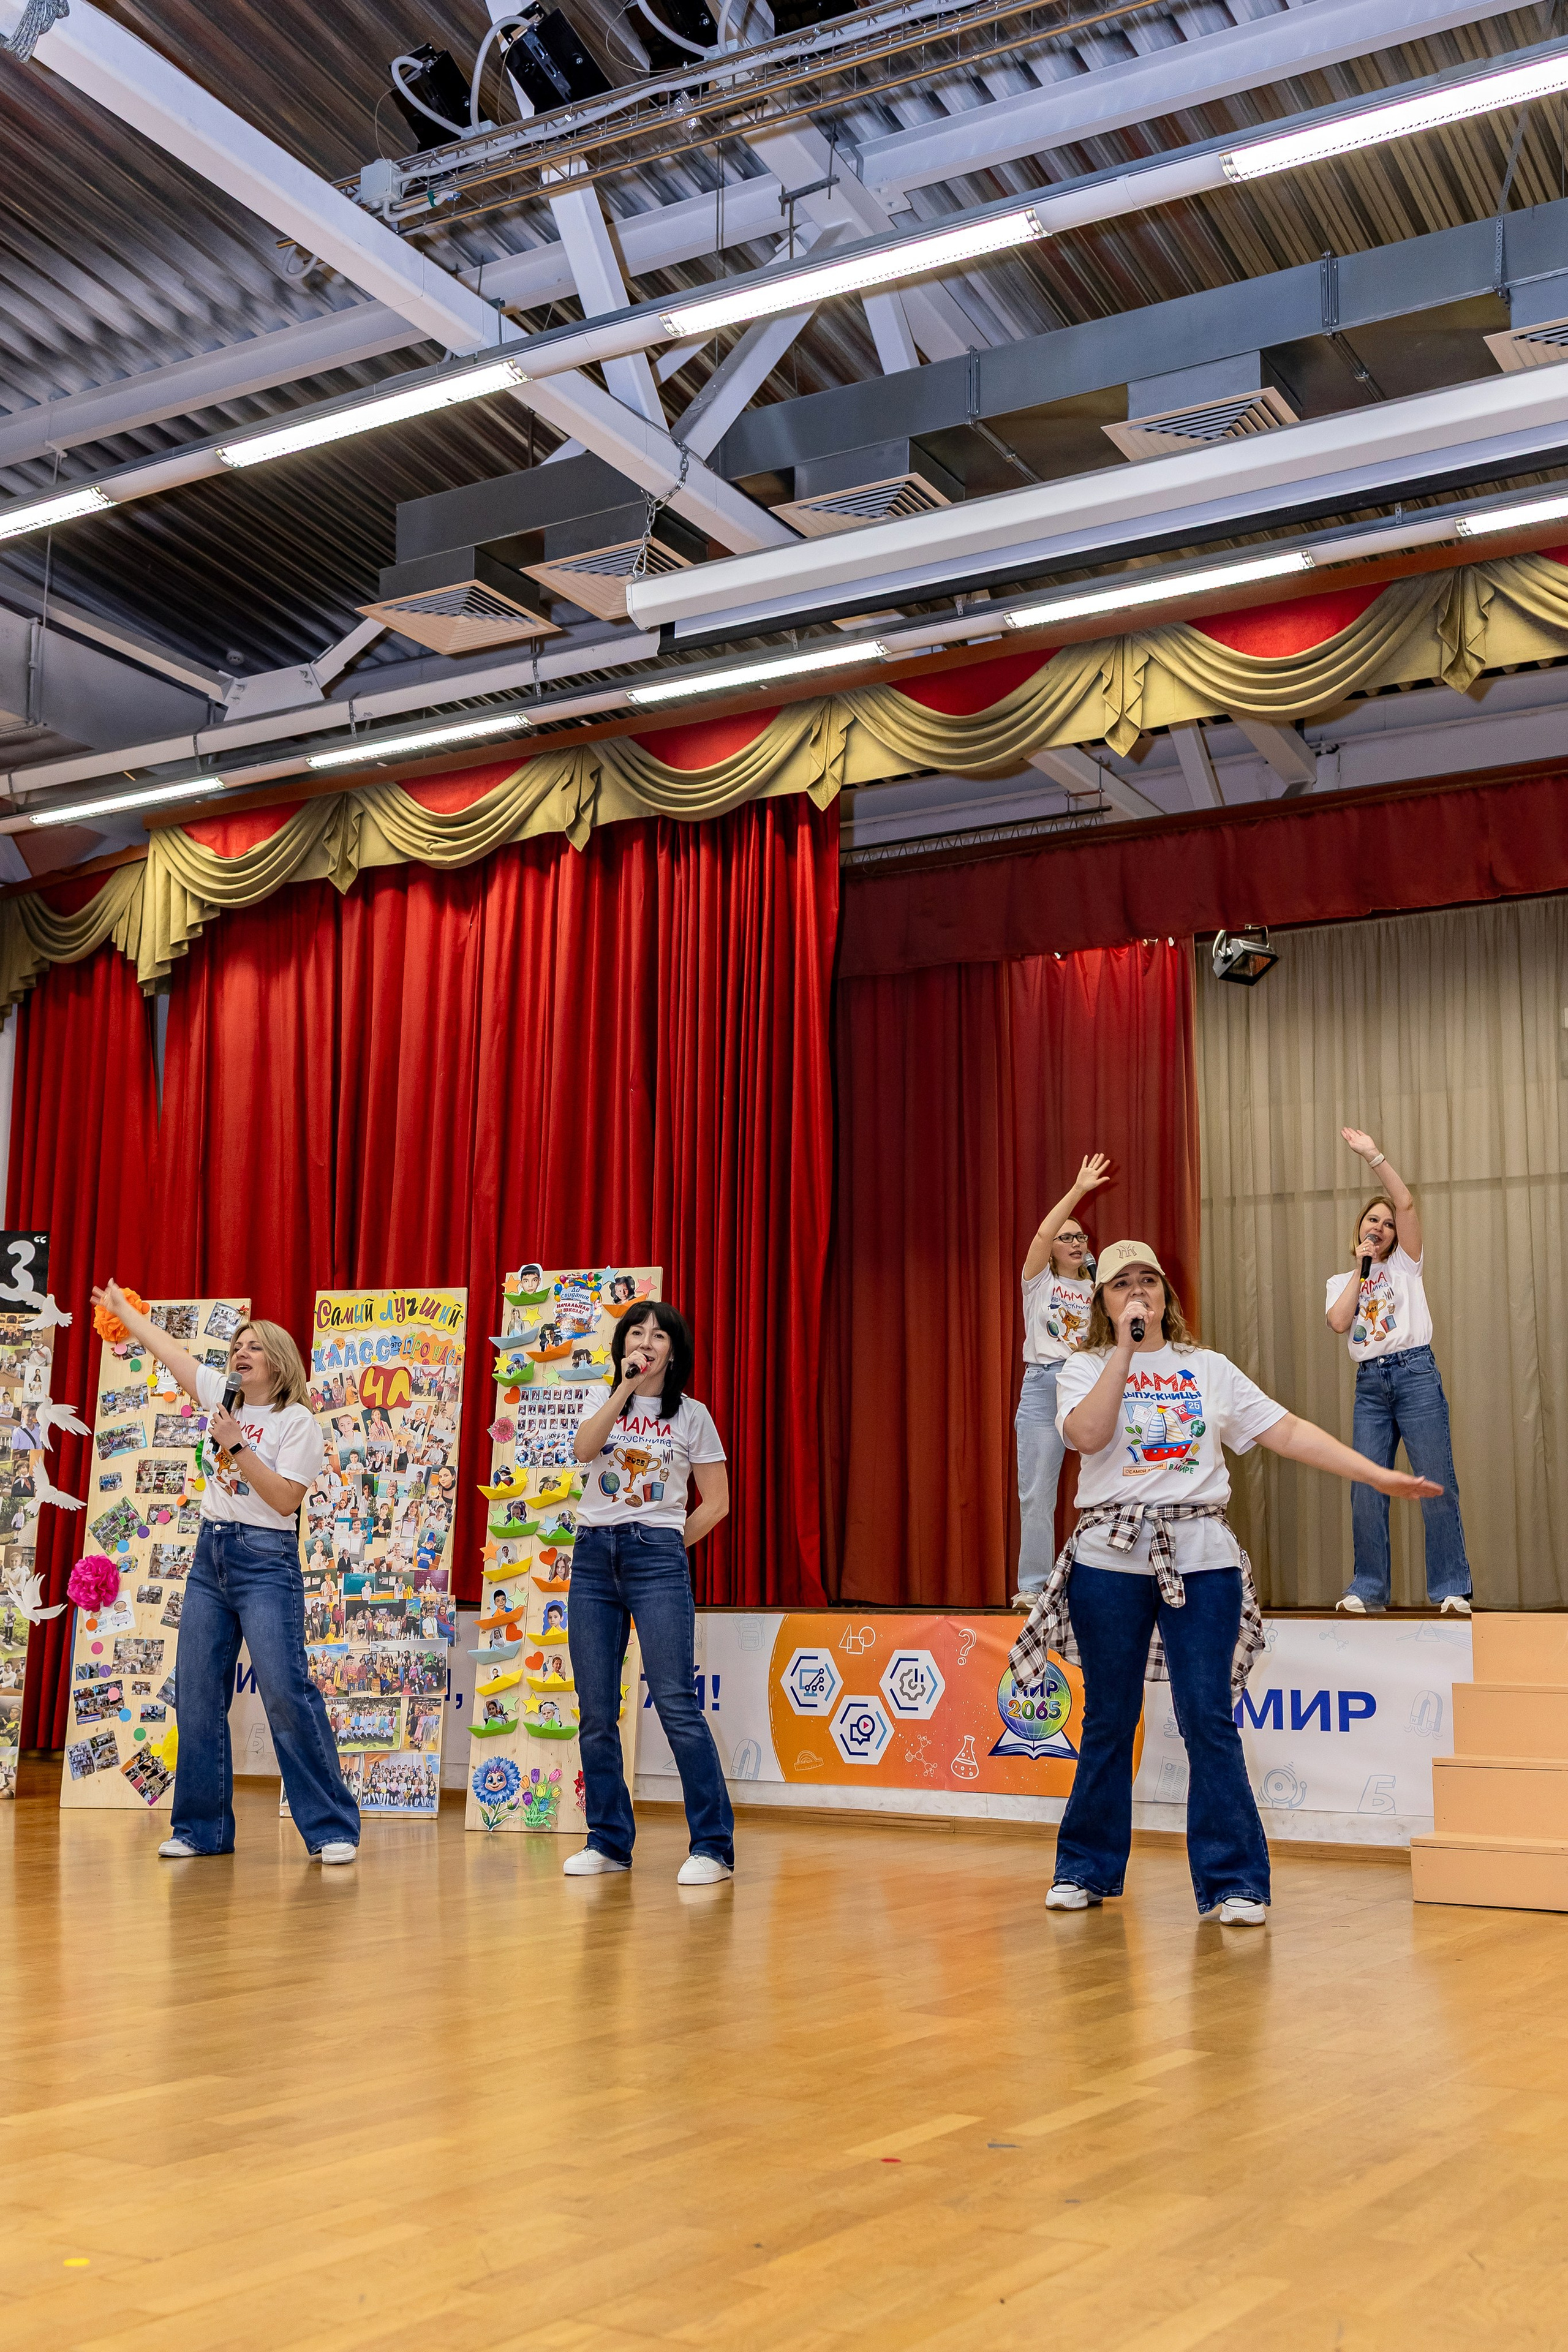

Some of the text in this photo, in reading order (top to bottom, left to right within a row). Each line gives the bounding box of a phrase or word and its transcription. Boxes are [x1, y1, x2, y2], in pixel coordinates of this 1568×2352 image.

[317, 1298, 374, 1329] Самый
[556, 1302, 590, 1312] НАЧАЛЬНАЯ
[314, 1335, 390, 1373] КЛАСС
[403, 1336, 431, 1359] ПРО
[626, 1456, 646, 1466] 2025
[1008, 1699, 1061, 1721] 2065
[1234, 1688, 1377, 1732] МИР
